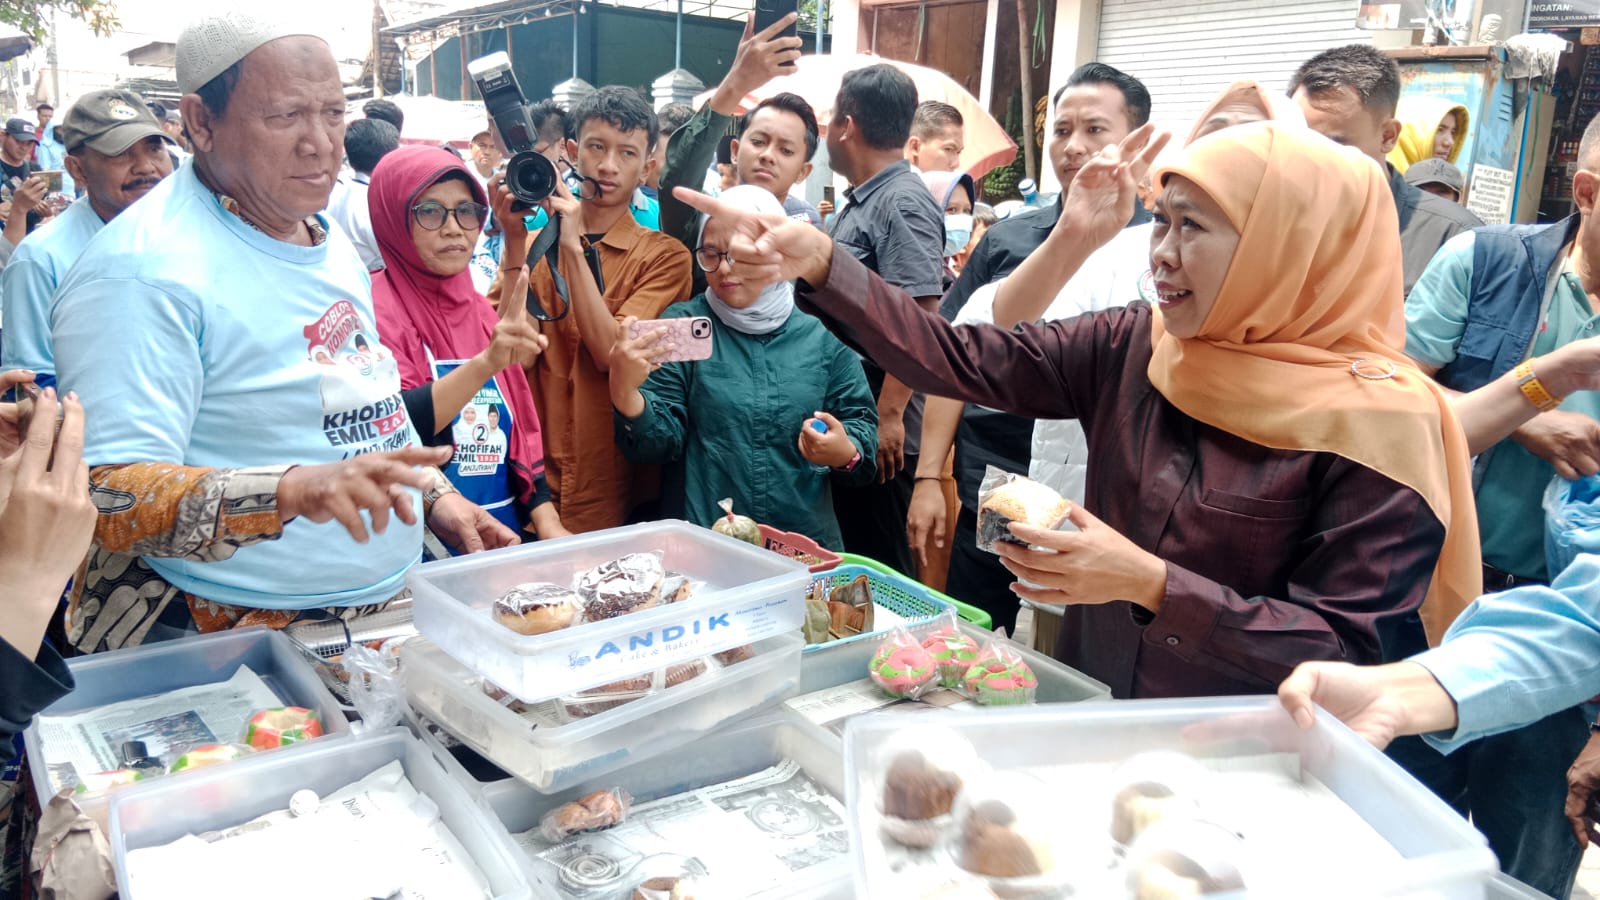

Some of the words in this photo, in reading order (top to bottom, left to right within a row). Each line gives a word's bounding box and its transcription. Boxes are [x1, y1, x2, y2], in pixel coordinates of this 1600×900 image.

[318, 302, 352, 340] COBLOS
[323, 391, 402, 430] KHOFIFA
[325, 422, 376, 446] EMIL
[476, 426, 486, 441] 2
[595, 612, 730, 659] ANDIK
